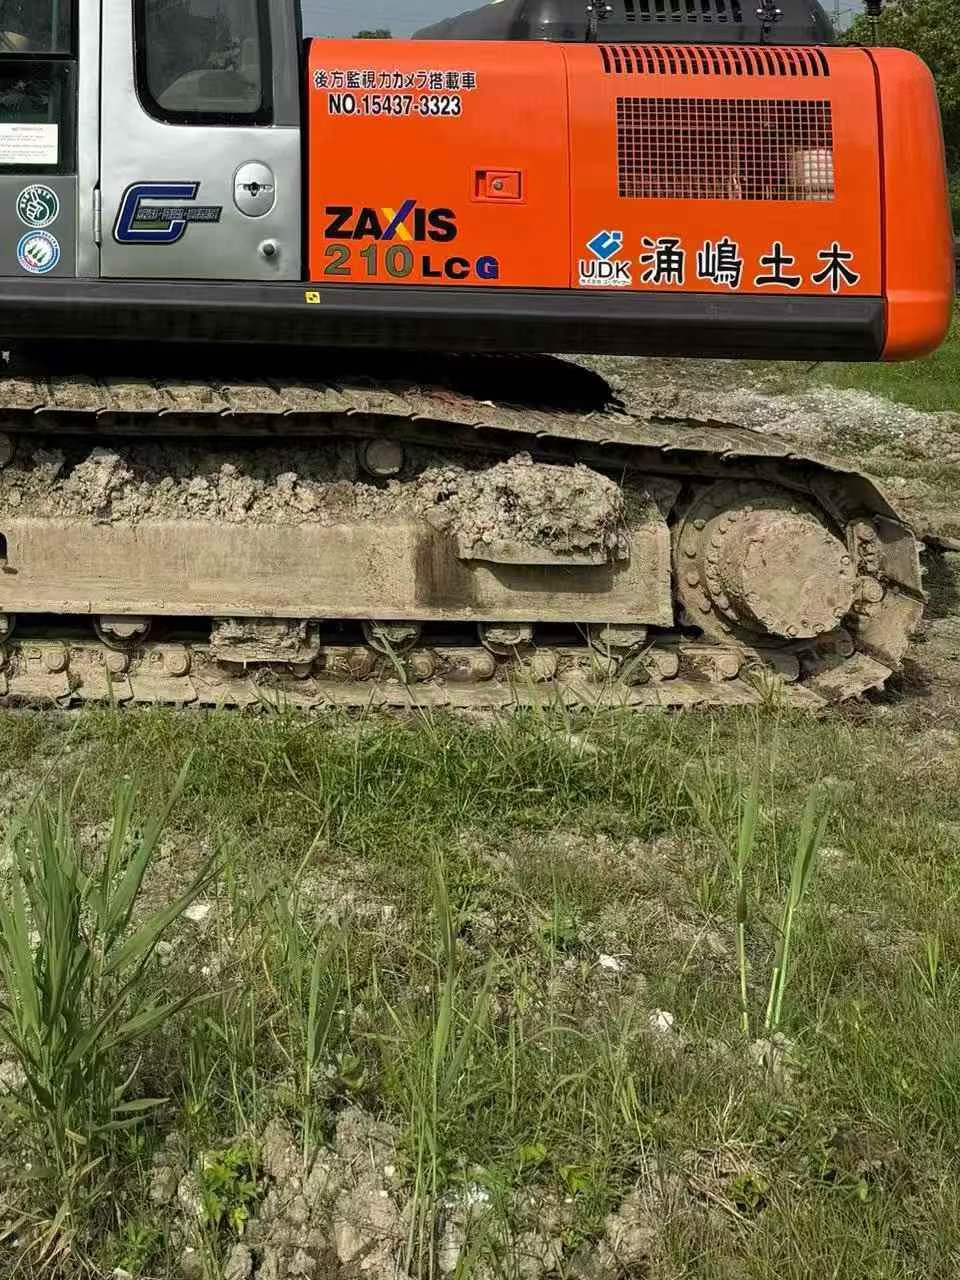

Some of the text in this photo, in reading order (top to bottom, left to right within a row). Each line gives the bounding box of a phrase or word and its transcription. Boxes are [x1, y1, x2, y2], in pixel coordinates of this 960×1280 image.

[328, 93, 462, 116] NO.15437-3323
[324, 199, 458, 243] ZAXIS
[323, 243, 415, 278] 210
[579, 260, 631, 279] UDK
